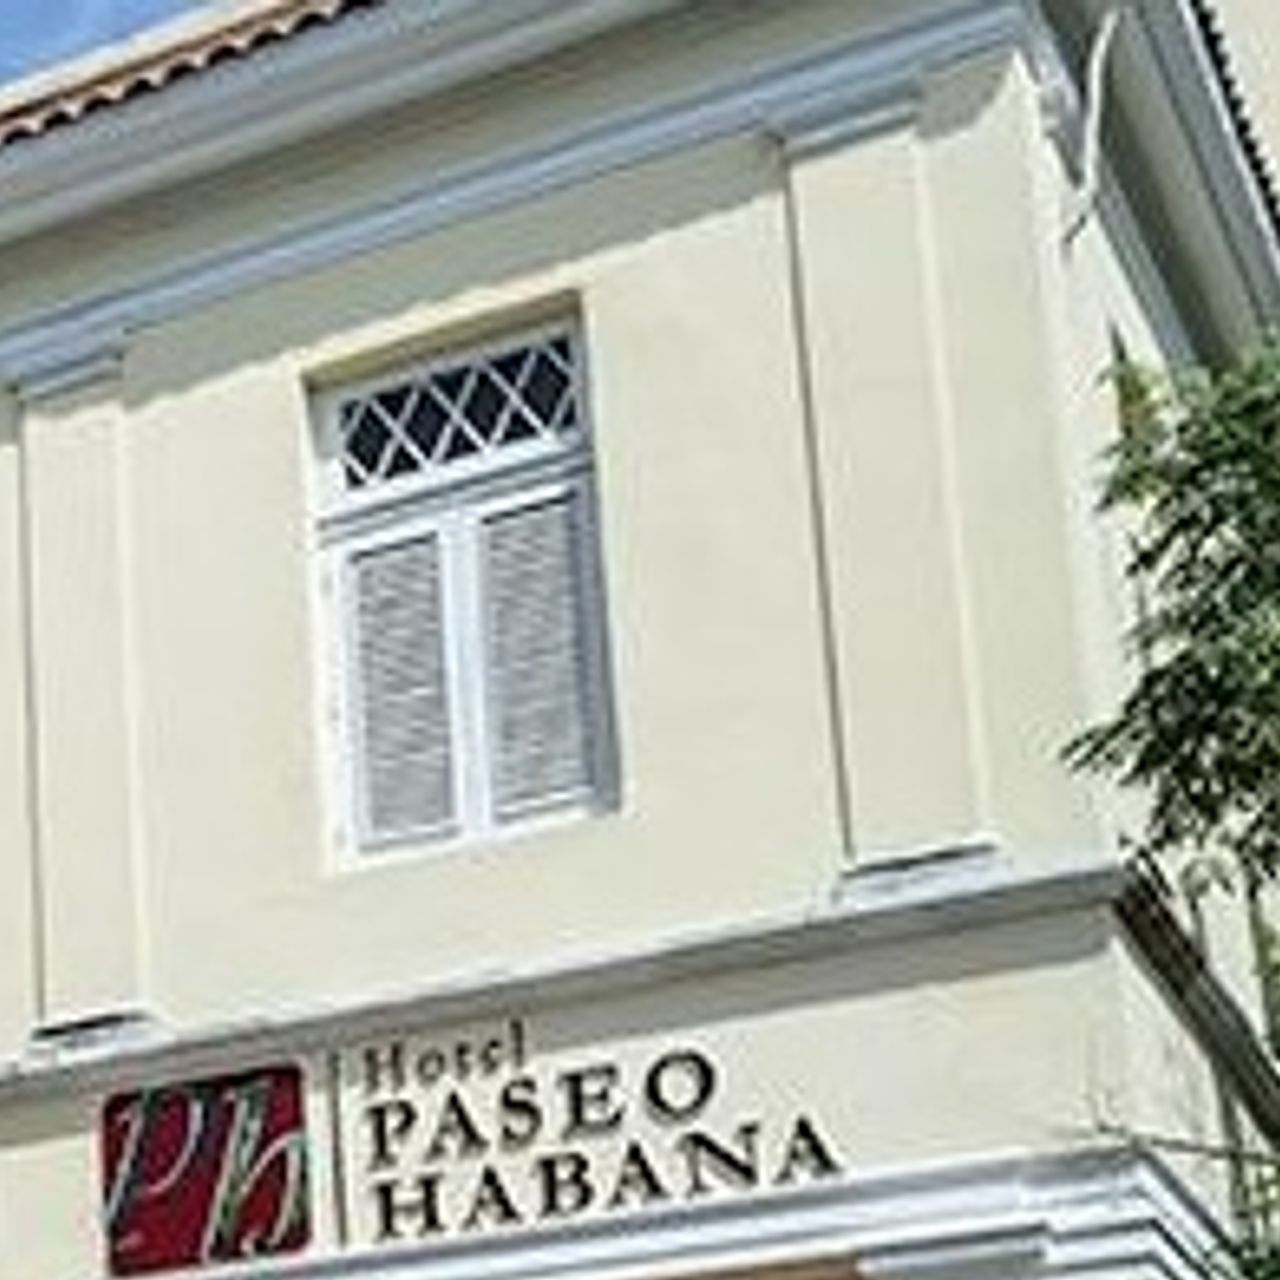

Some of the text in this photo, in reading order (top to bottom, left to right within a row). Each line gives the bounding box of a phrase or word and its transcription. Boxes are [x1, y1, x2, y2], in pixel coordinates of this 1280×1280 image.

[364, 1021, 526, 1093] Hotel
[367, 1049, 717, 1170] PASEO
[376, 1114, 843, 1241] HABANA
